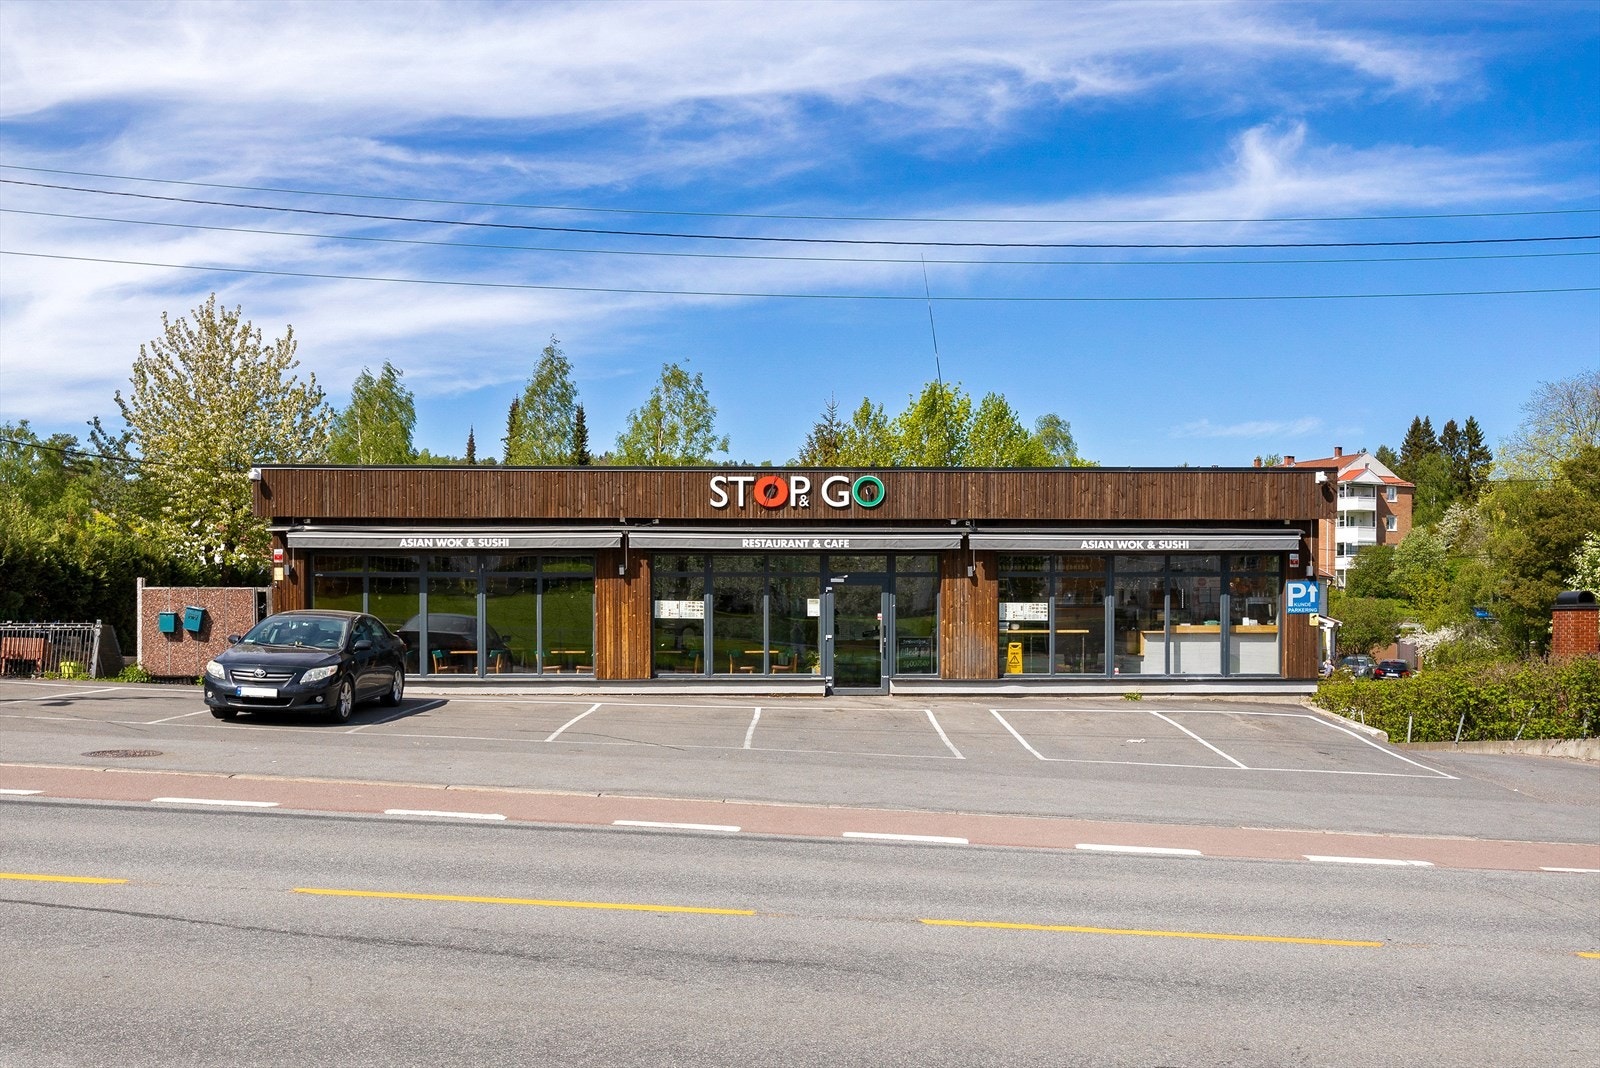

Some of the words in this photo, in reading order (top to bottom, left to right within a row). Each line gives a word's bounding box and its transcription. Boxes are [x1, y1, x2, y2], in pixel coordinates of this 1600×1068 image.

[709, 475, 811, 507] STOP
[799, 494, 810, 507] &
[821, 475, 885, 507] GO
[399, 538, 433, 547] ASIAN
[436, 538, 463, 547] WOK
[466, 538, 475, 547] &
[478, 538, 509, 547] SUSHI
[742, 539, 809, 548] RESTAURANT
[812, 539, 821, 548] &
[824, 539, 850, 548] CAFE
[1081, 540, 1114, 549] ASIAN
[1117, 540, 1144, 549] WOK
[1147, 540, 1156, 549] &
[1159, 540, 1189, 549] SUSHI
[1288, 583, 1306, 607] P
